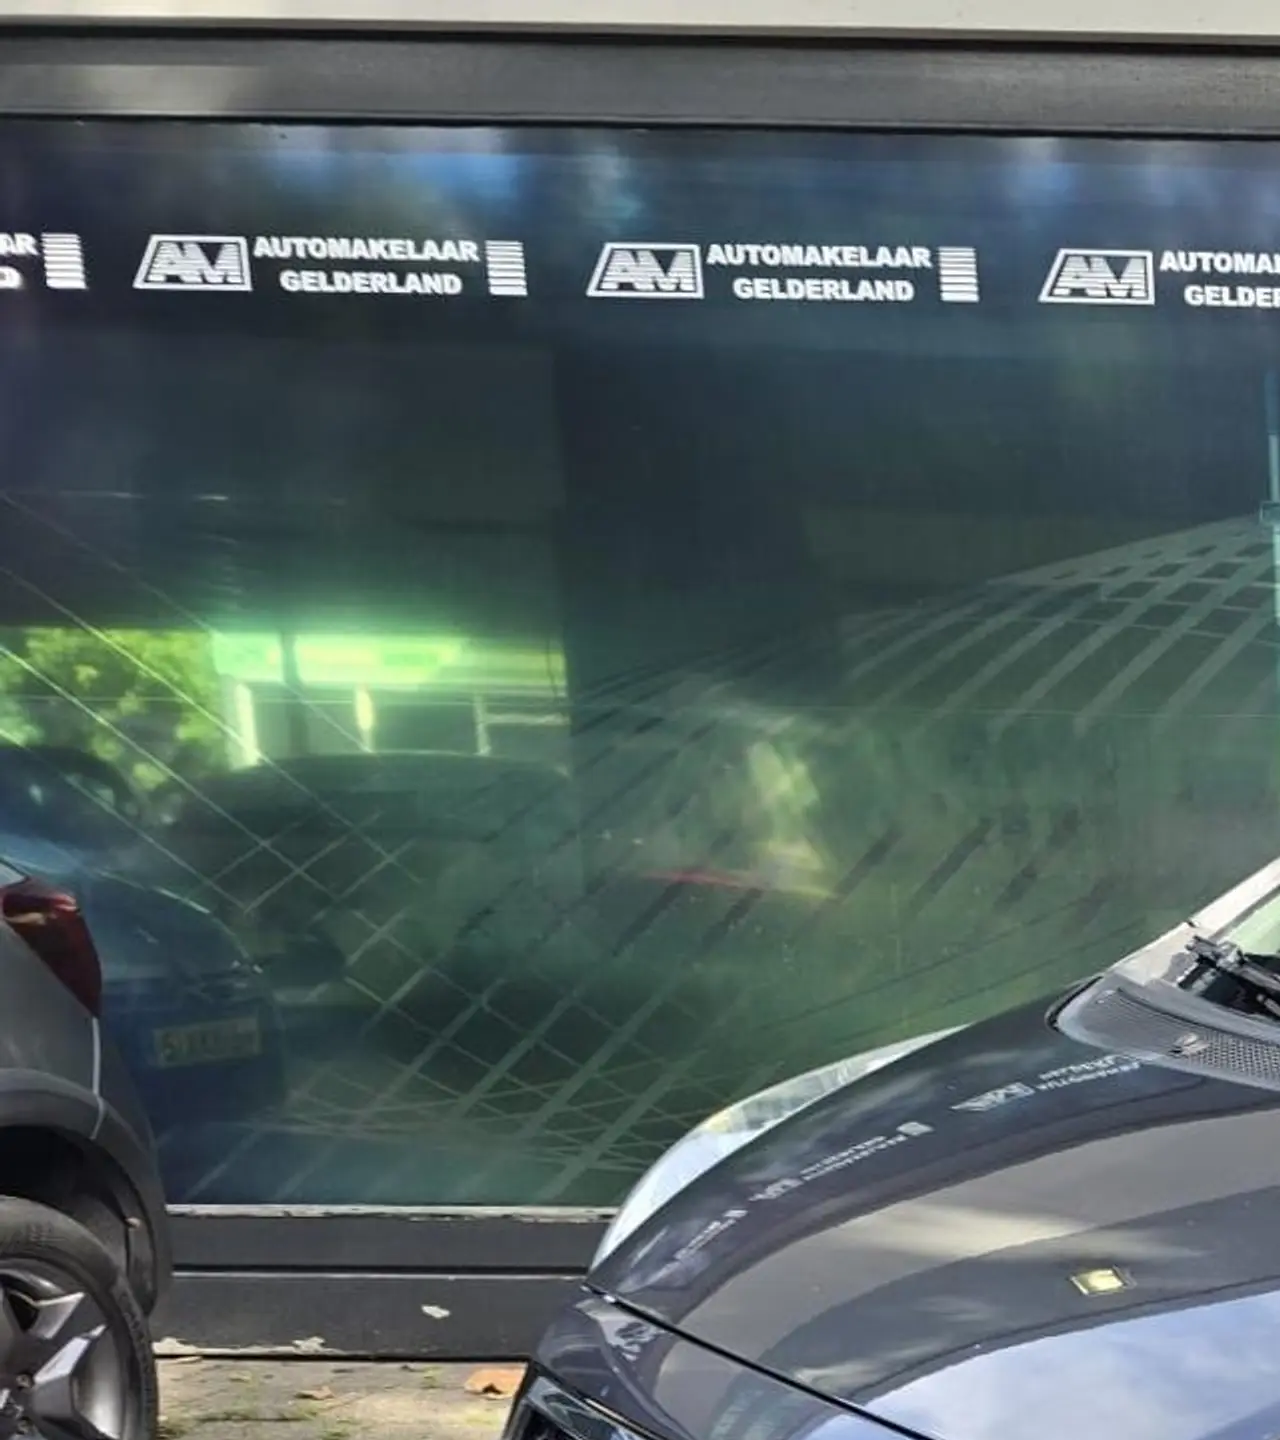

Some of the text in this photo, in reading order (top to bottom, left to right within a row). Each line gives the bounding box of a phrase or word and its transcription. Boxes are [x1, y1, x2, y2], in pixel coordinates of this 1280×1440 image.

[253, 236, 481, 262] AUTOMAKELAAR
[706, 243, 932, 269] AUTOMAKELAAR
[147, 241, 244, 284] AM
[601, 250, 697, 292] AM
[279, 270, 463, 295] GELDERLAND
[732, 277, 915, 302] GELDERLAND
[1053, 256, 1147, 299] AM
